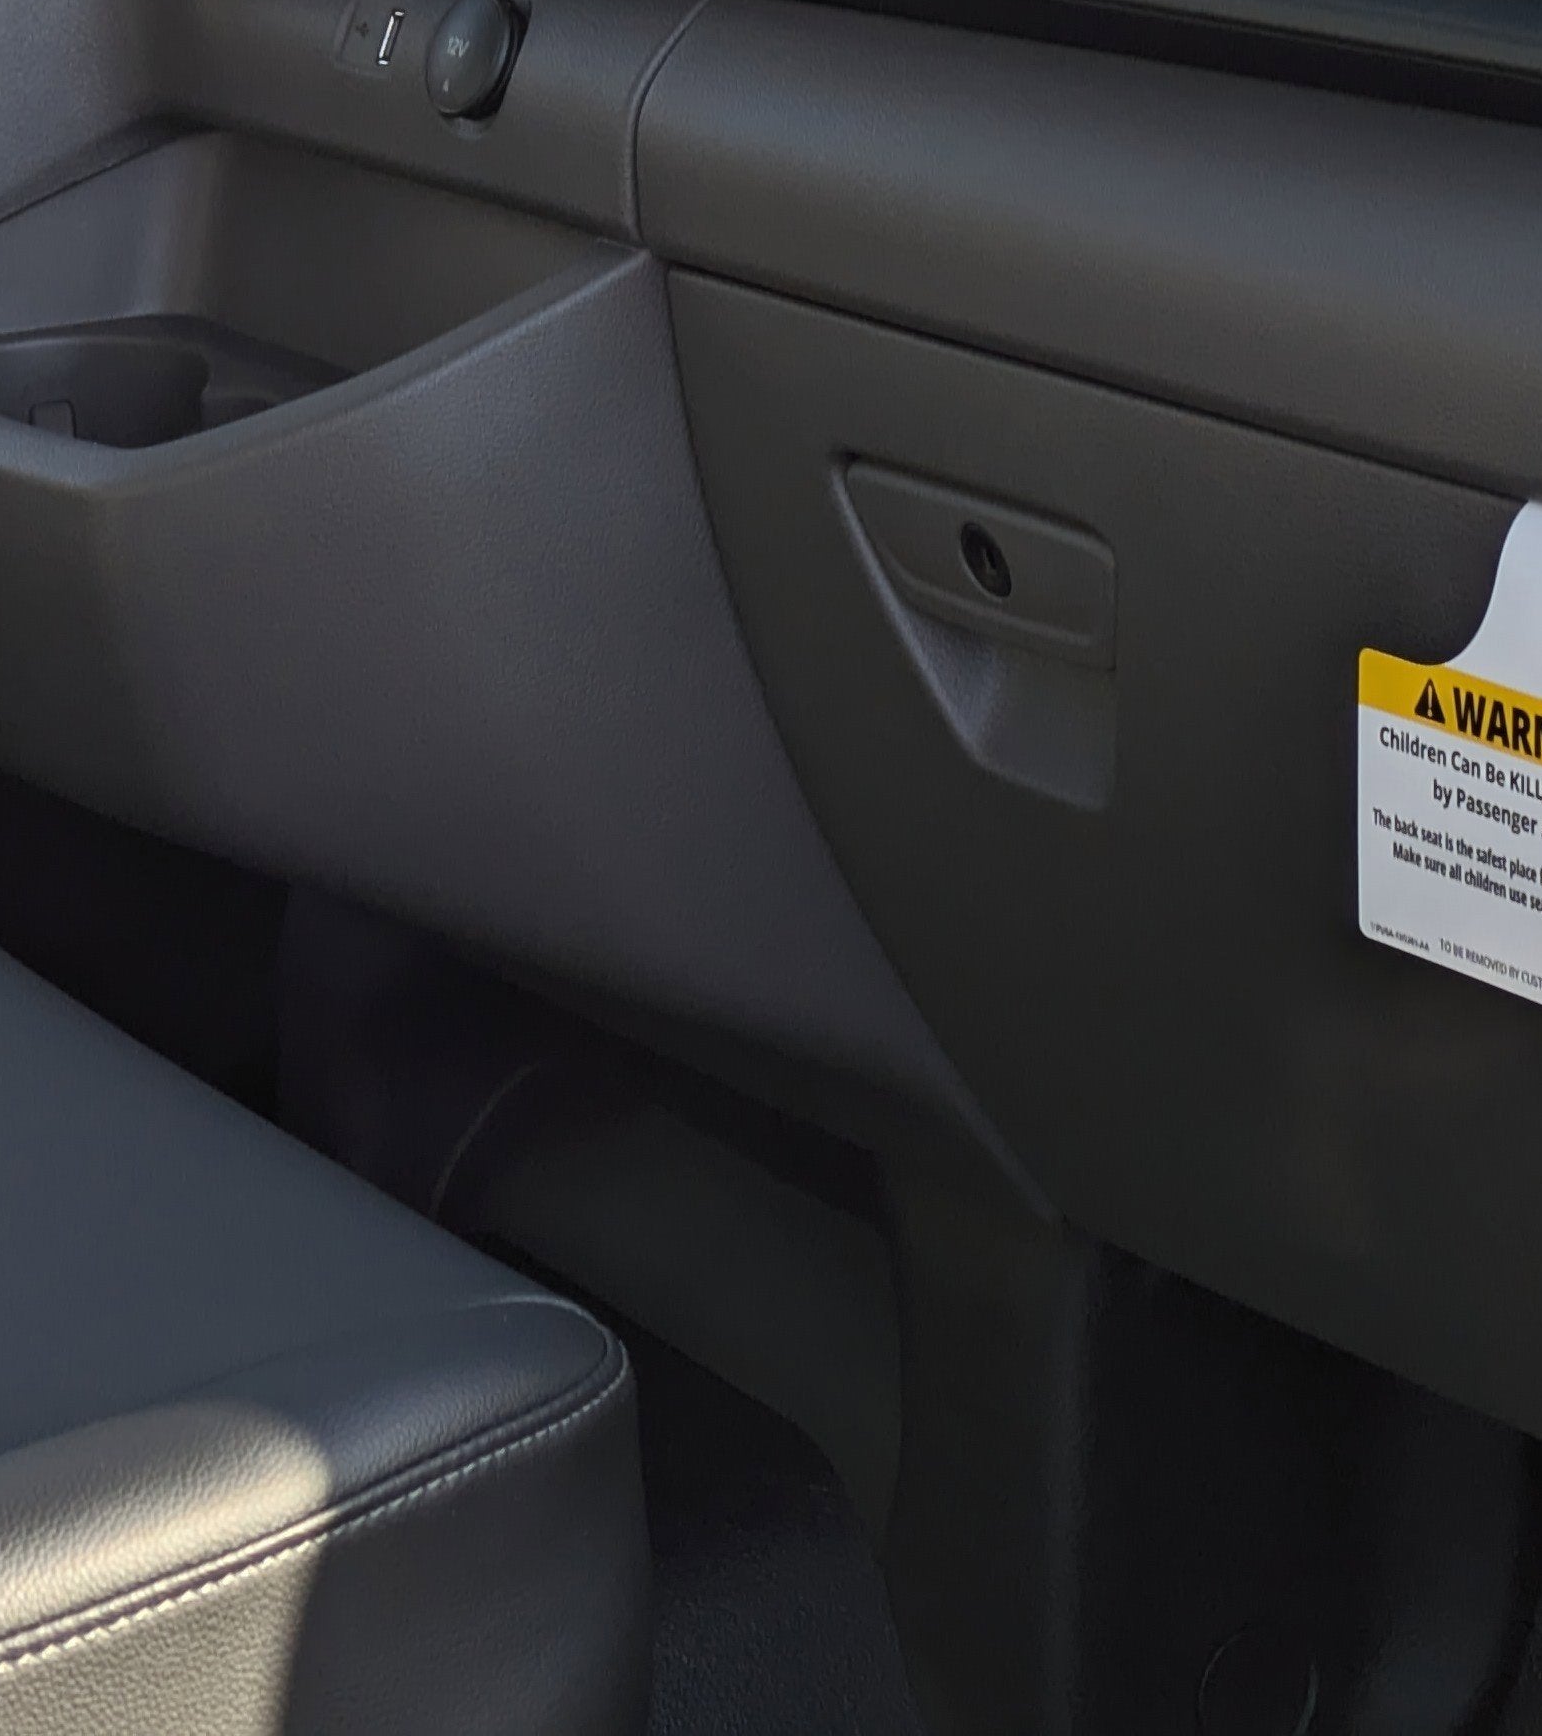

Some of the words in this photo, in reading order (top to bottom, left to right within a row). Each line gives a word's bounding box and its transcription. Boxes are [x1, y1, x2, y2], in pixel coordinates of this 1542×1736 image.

[446, 34, 471, 59] 12V
[1379, 726, 1447, 767] Children
[1451, 750, 1481, 779] Can
[1485, 762, 1506, 788] Be
[1433, 778, 1452, 809] by
[1456, 787, 1538, 835] Passenger
[1373, 806, 1392, 830] The
[1394, 814, 1418, 839] back
[1421, 827, 1443, 848] seat
[1445, 832, 1454, 852] is
[1456, 838, 1473, 859] the
[1476, 846, 1507, 872] safest
[1509, 858, 1537, 883] place
[1393, 841, 1421, 867] Make
[1424, 855, 1447, 877] sure
[1449, 863, 1462, 882] all
[1464, 868, 1507, 899] children
[1509, 887, 1527, 907] use
[1440, 937, 1452, 954] TO
[1453, 942, 1464, 960] BE
[1465, 948, 1507, 976] REMOVED
[1509, 964, 1521, 981] BY
